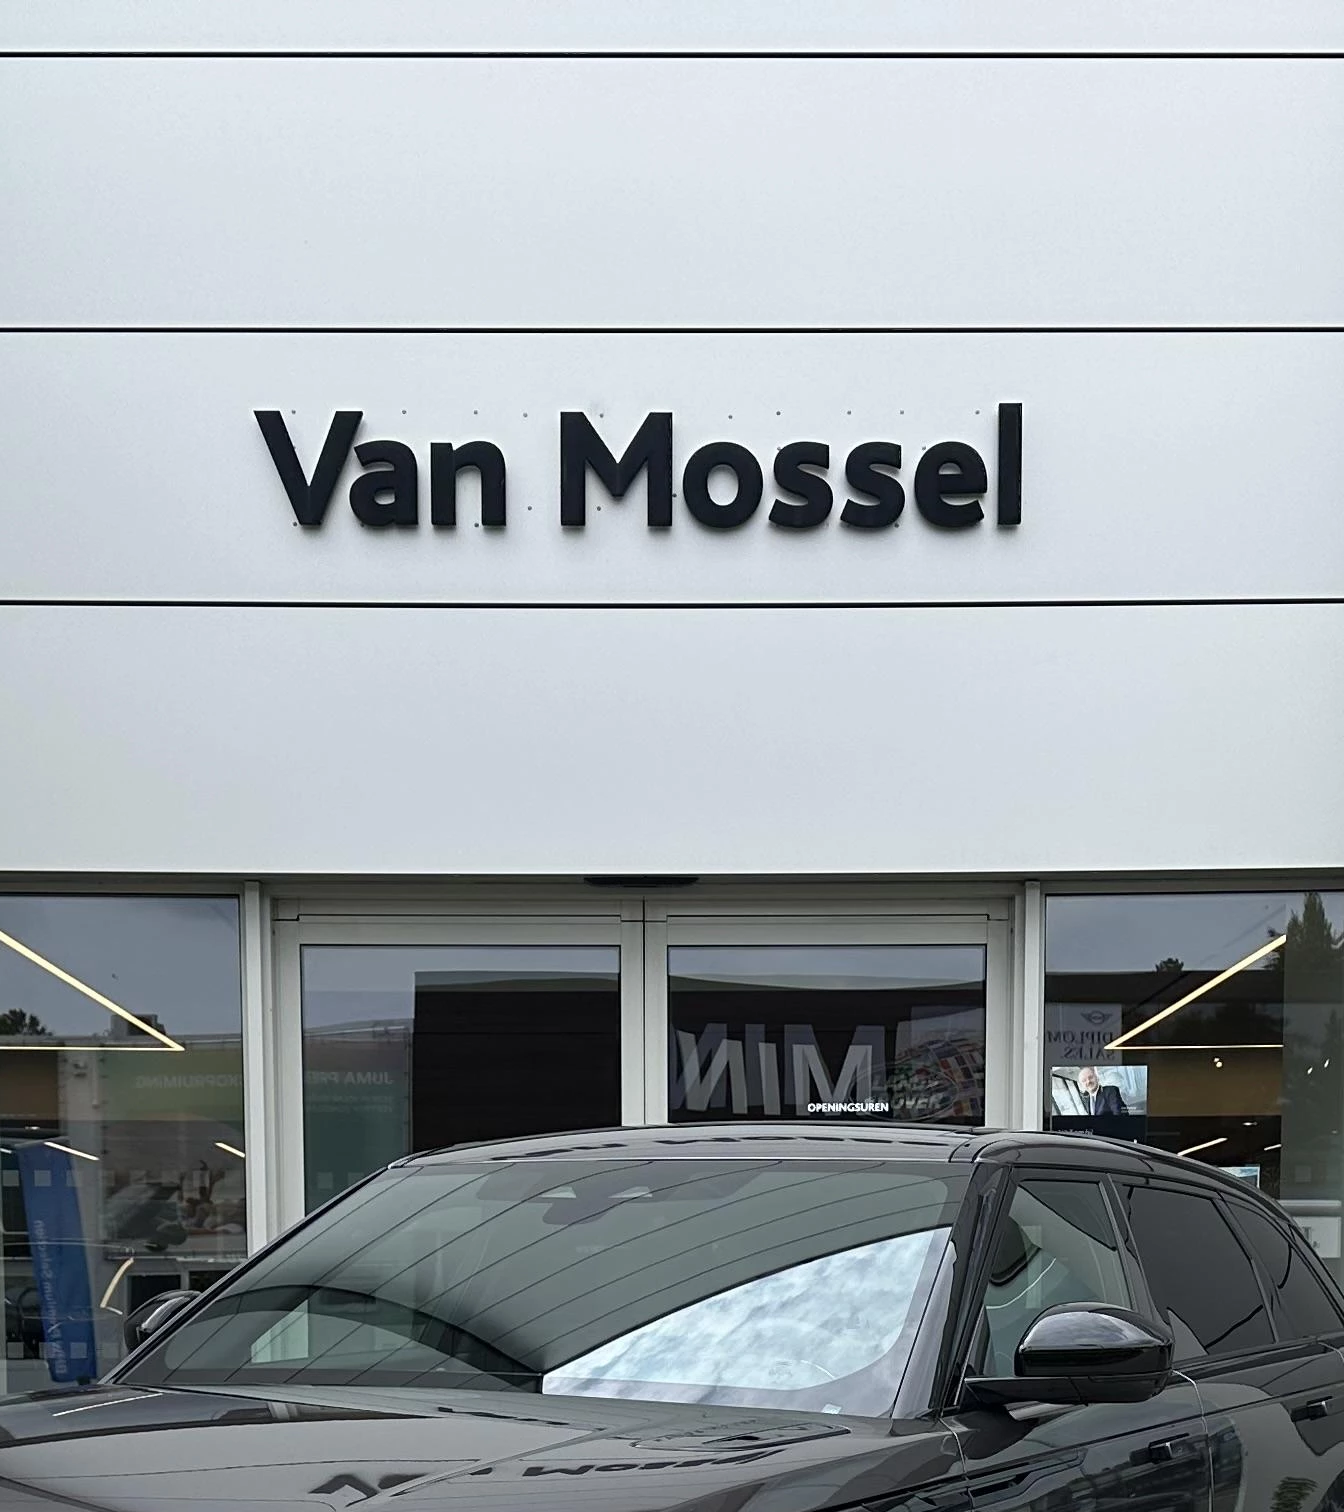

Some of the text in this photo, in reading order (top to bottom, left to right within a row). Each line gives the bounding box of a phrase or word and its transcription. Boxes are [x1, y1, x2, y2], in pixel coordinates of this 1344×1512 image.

[253, 402, 1023, 531] Van Mossel
[807, 1102, 889, 1112] OPENINGSUREN
